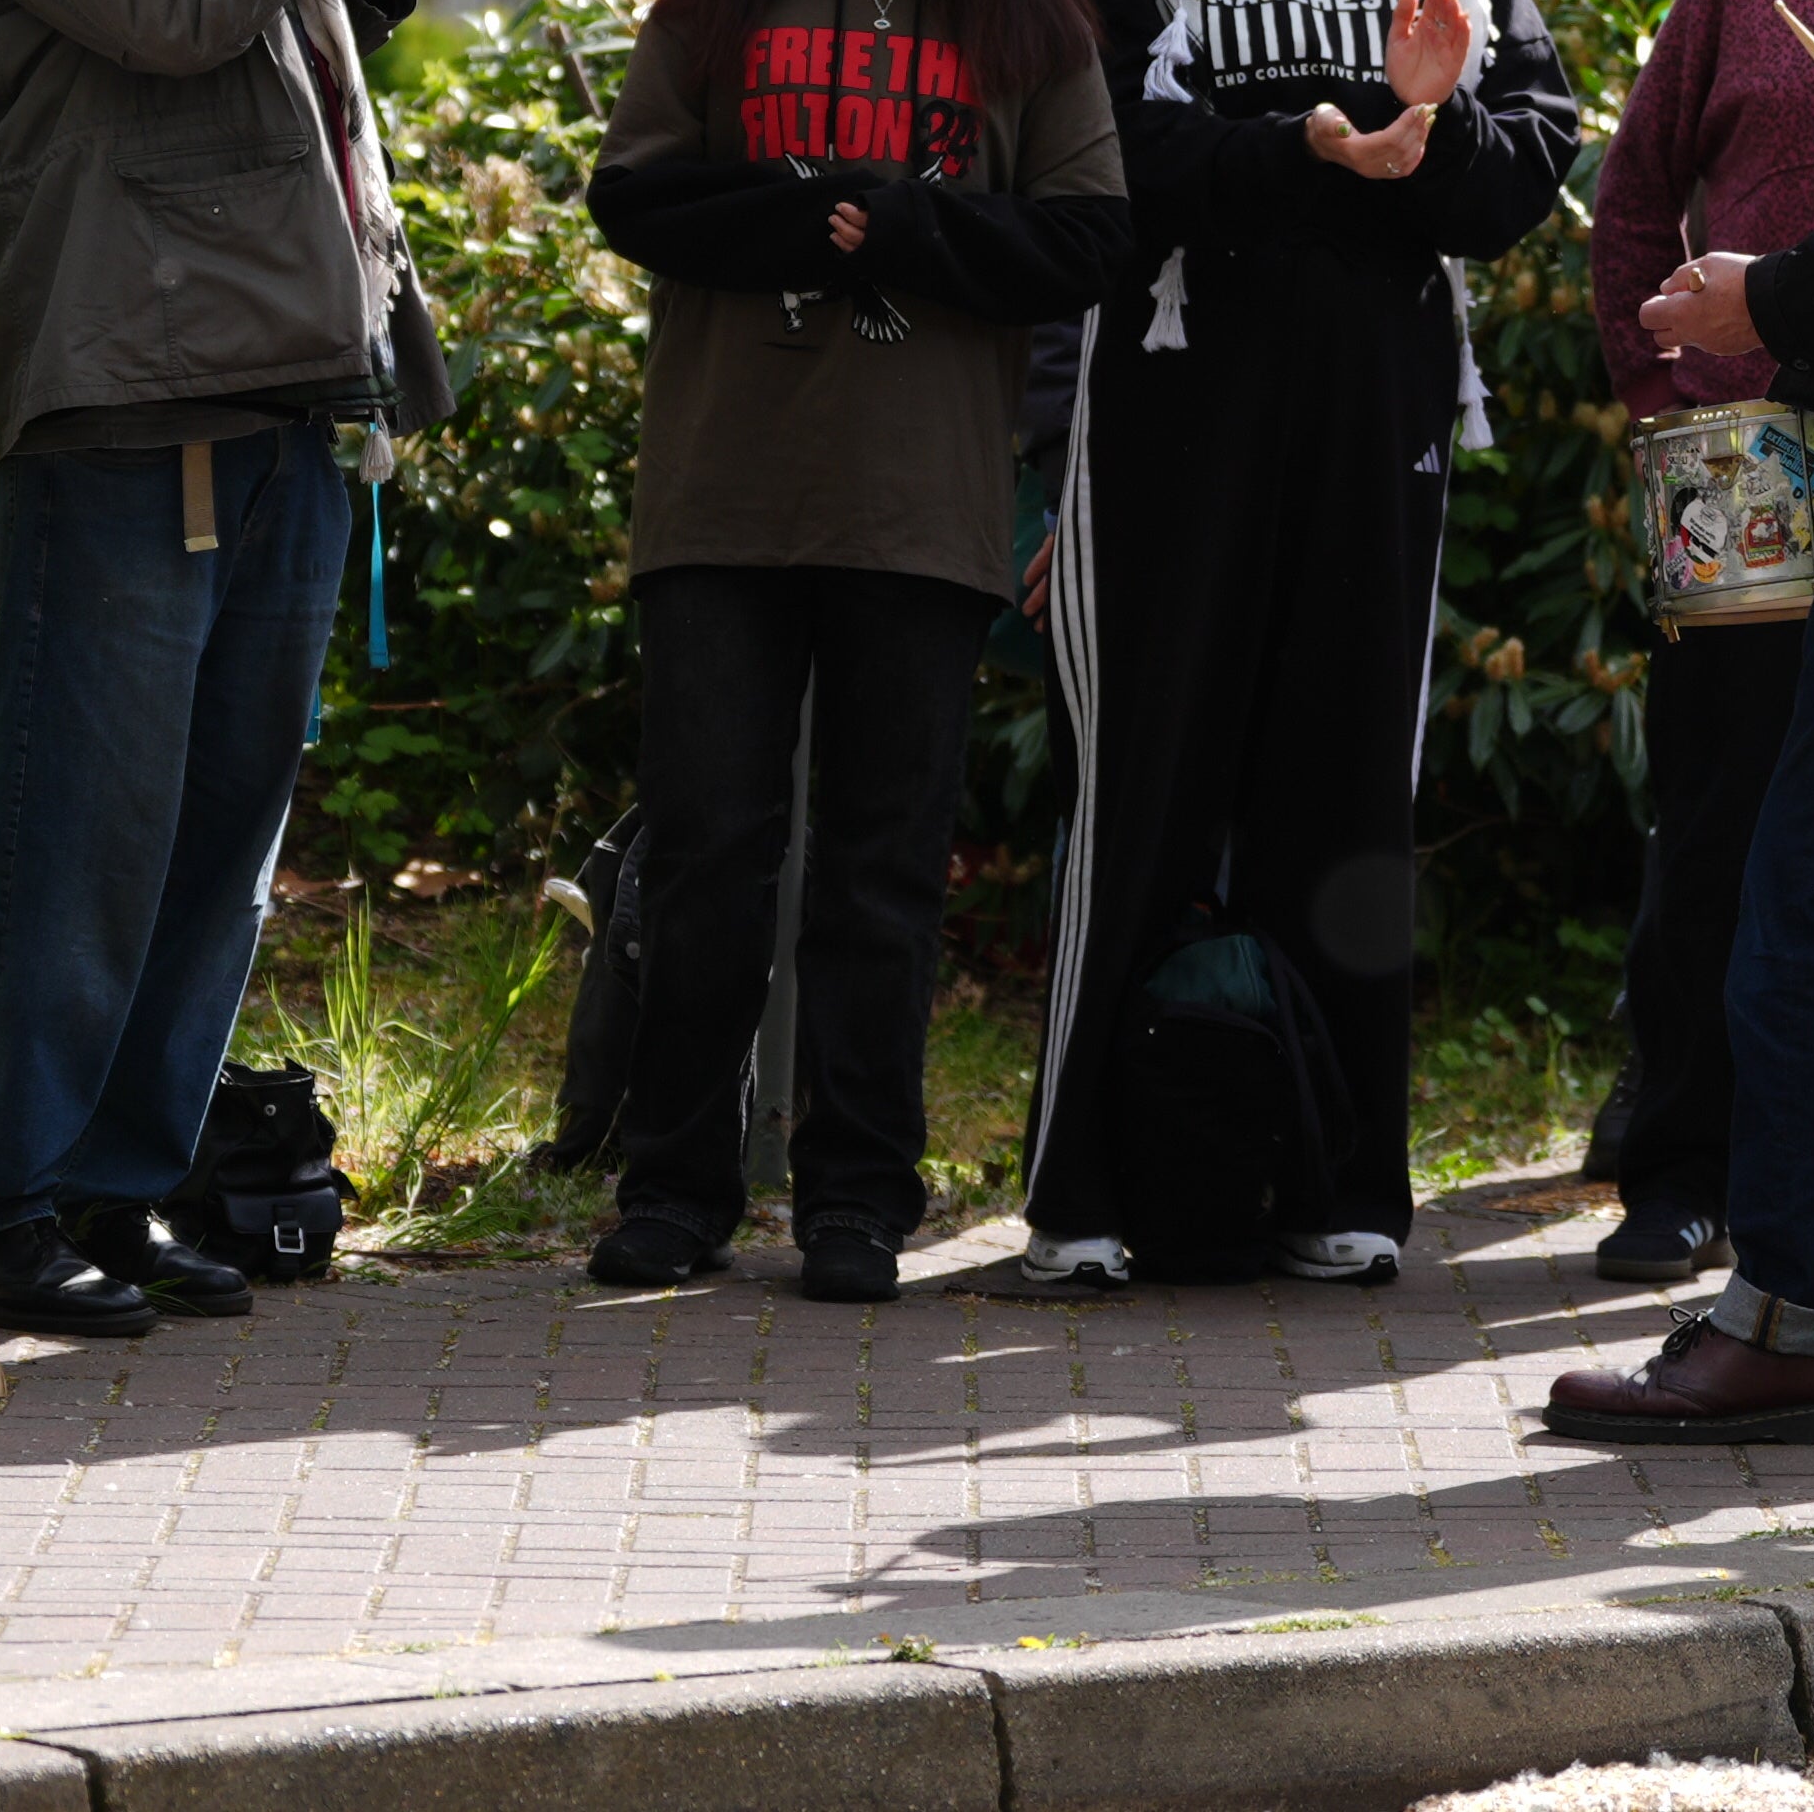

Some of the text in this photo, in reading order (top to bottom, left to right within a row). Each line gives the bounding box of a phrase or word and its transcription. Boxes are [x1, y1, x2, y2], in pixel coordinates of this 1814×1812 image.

[744, 26, 876, 90] FREE
[1215, 71, 1247, 88] END
[1255, 63, 1355, 82] COLLECTIVE
[740, 92, 913, 163] FILTON
